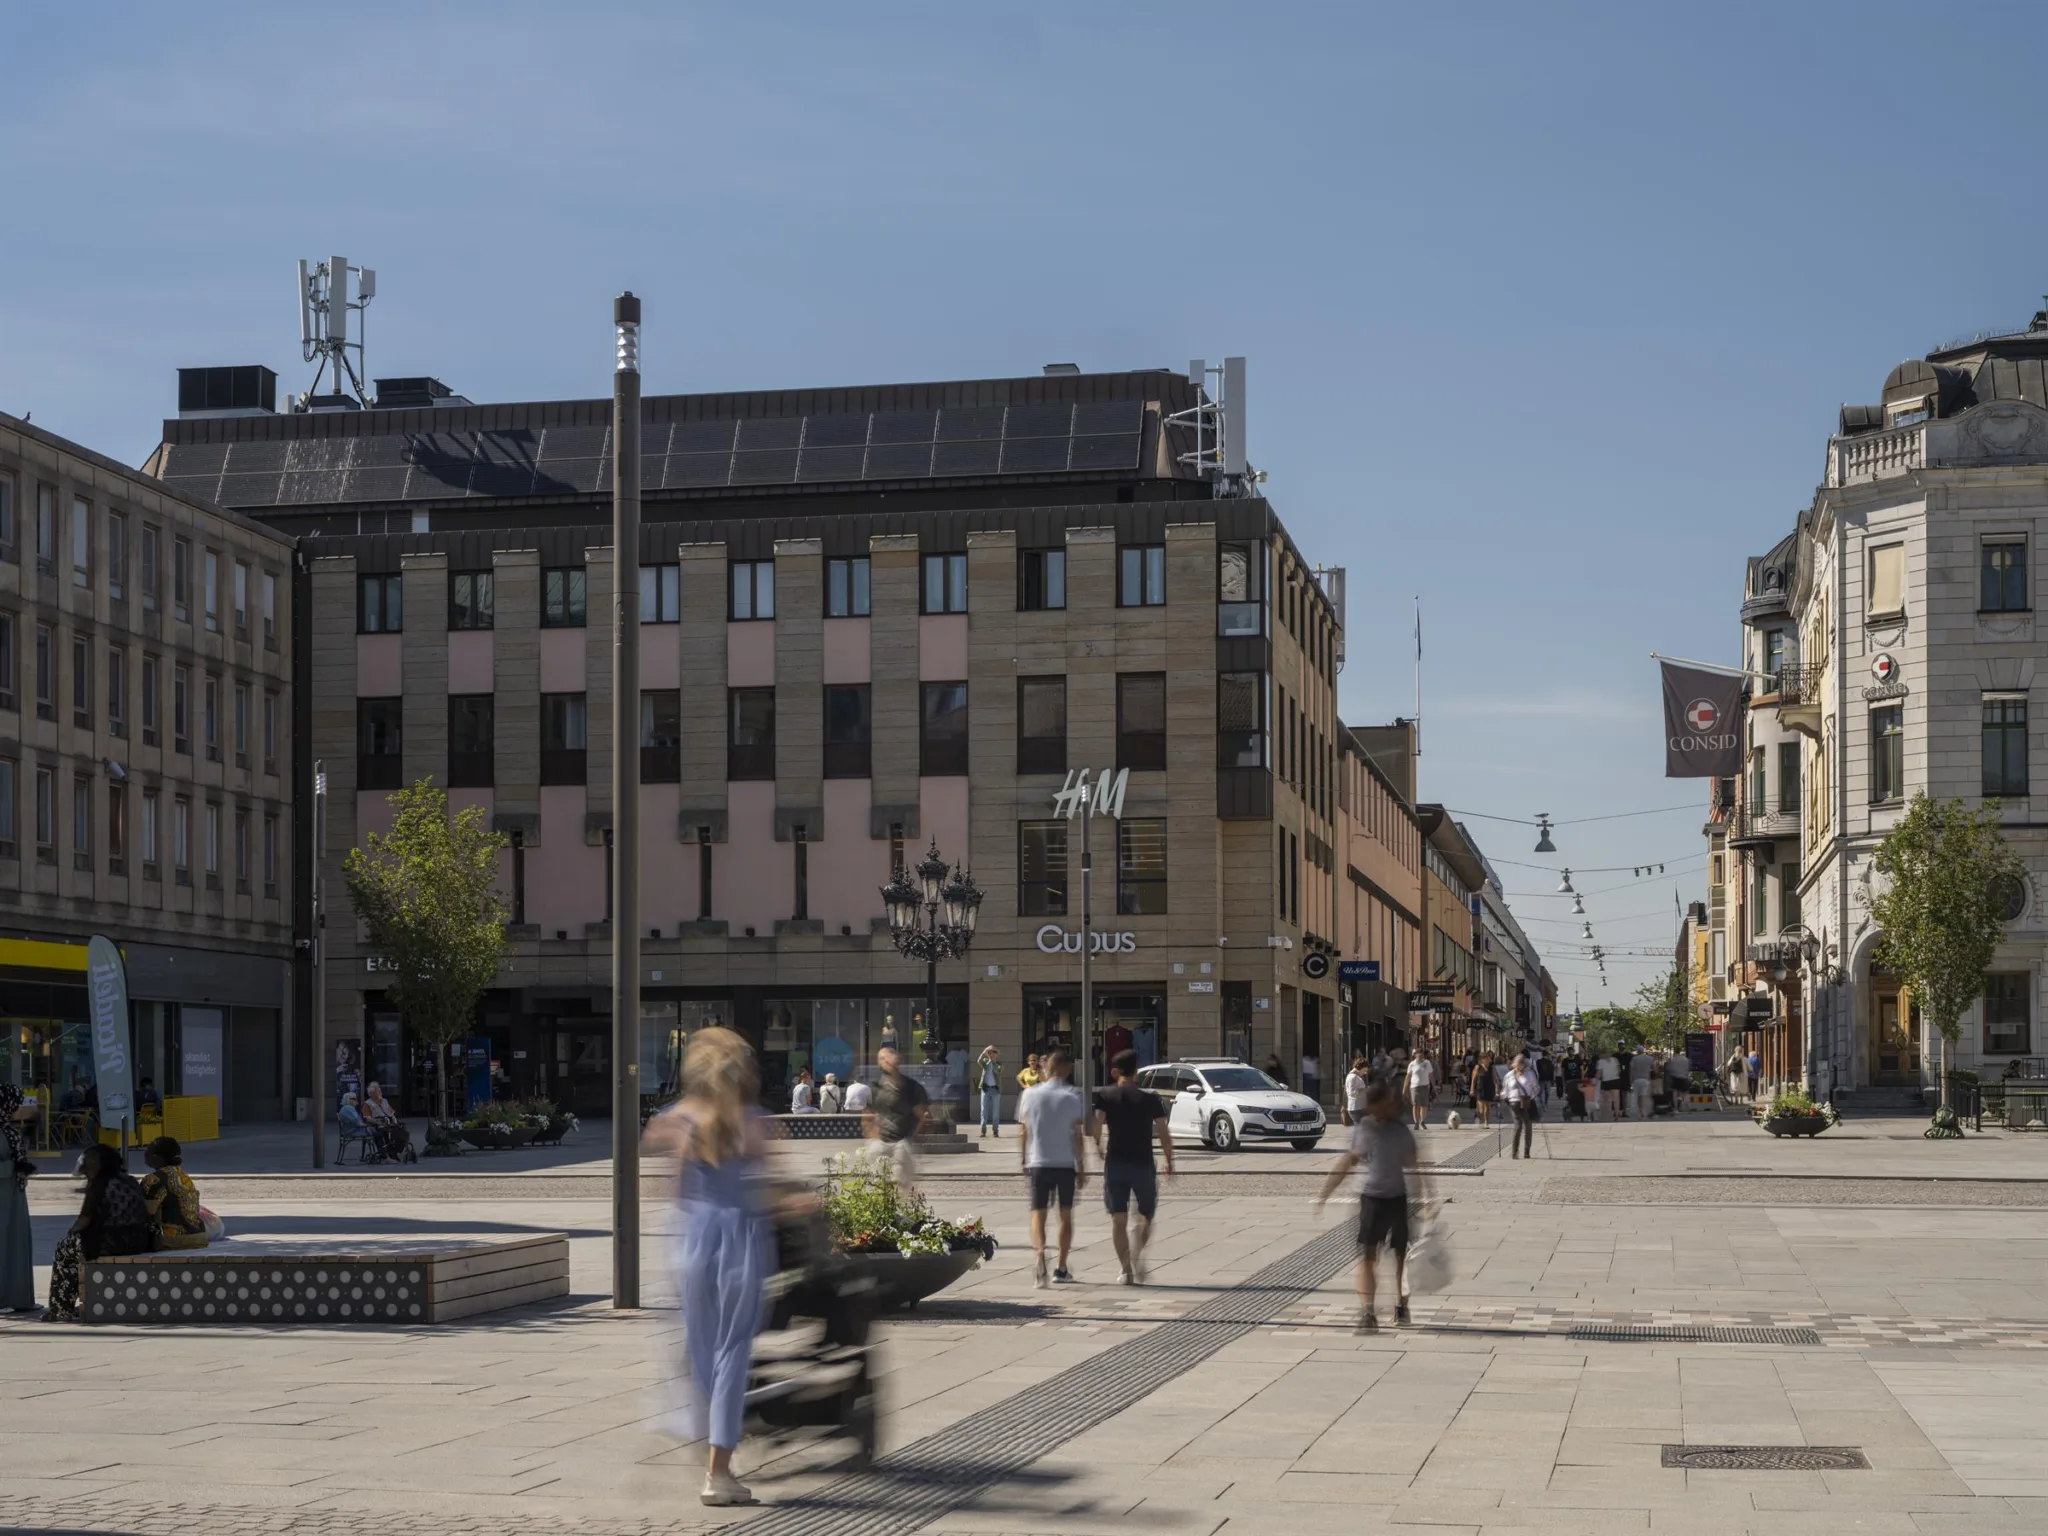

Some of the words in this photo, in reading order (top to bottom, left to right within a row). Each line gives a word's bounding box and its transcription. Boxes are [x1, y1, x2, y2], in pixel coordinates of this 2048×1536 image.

[1861, 683, 1910, 698] CONSID
[1669, 733, 1737, 751] CONSID
[1052, 767, 1129, 820] HM
